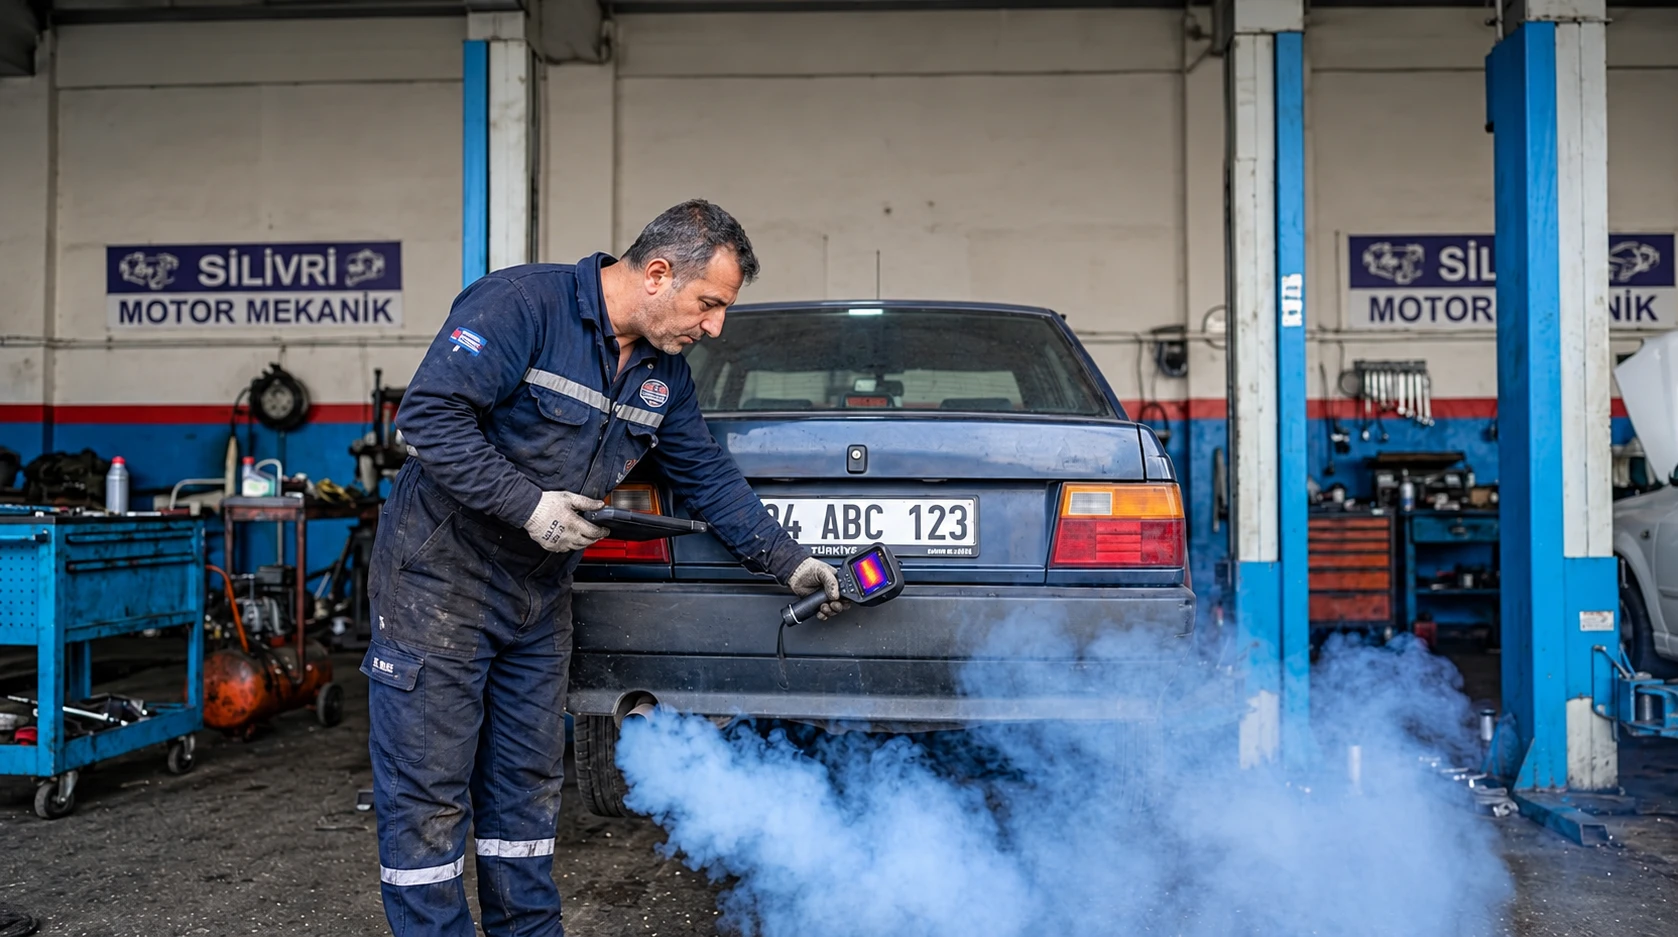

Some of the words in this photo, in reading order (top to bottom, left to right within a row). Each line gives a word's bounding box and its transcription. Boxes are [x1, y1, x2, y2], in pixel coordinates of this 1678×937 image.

[198, 247, 337, 287] SİLİVRİ
[119, 299, 235, 325] MOTOR
[247, 291, 393, 324] MEKANİK
[1368, 294, 1494, 323] MOTOR
[821, 503, 884, 540] ABC
[909, 504, 968, 541] 123
